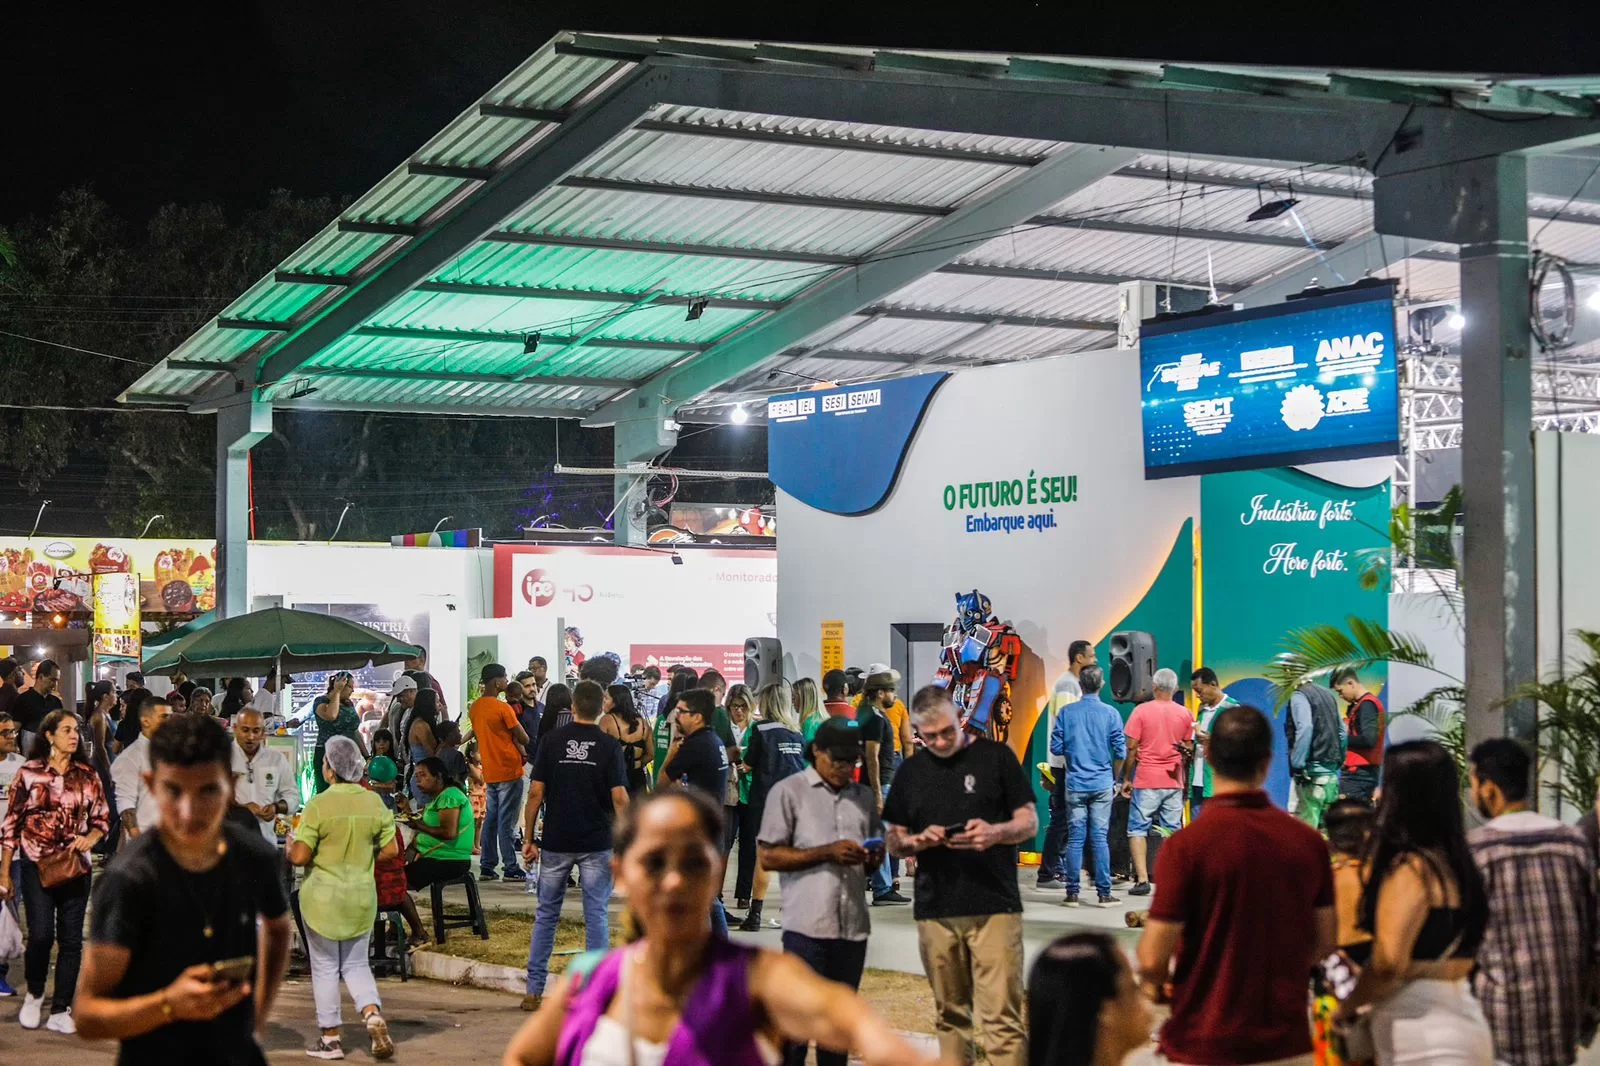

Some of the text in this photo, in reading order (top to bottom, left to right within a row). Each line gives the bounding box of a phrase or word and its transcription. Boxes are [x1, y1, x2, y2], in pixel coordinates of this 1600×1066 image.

[1315, 331, 1384, 362] ANAC
[800, 400, 814, 412] IEL
[824, 391, 879, 409] SESI SENAI
[943, 469, 1077, 511] O FUTURO É SEU!
[966, 508, 1057, 534] Embarque aqui.
[1240, 493, 1318, 526] Indústria
[1263, 542, 1349, 579] Acre forte.
[566, 739, 589, 760] 35
